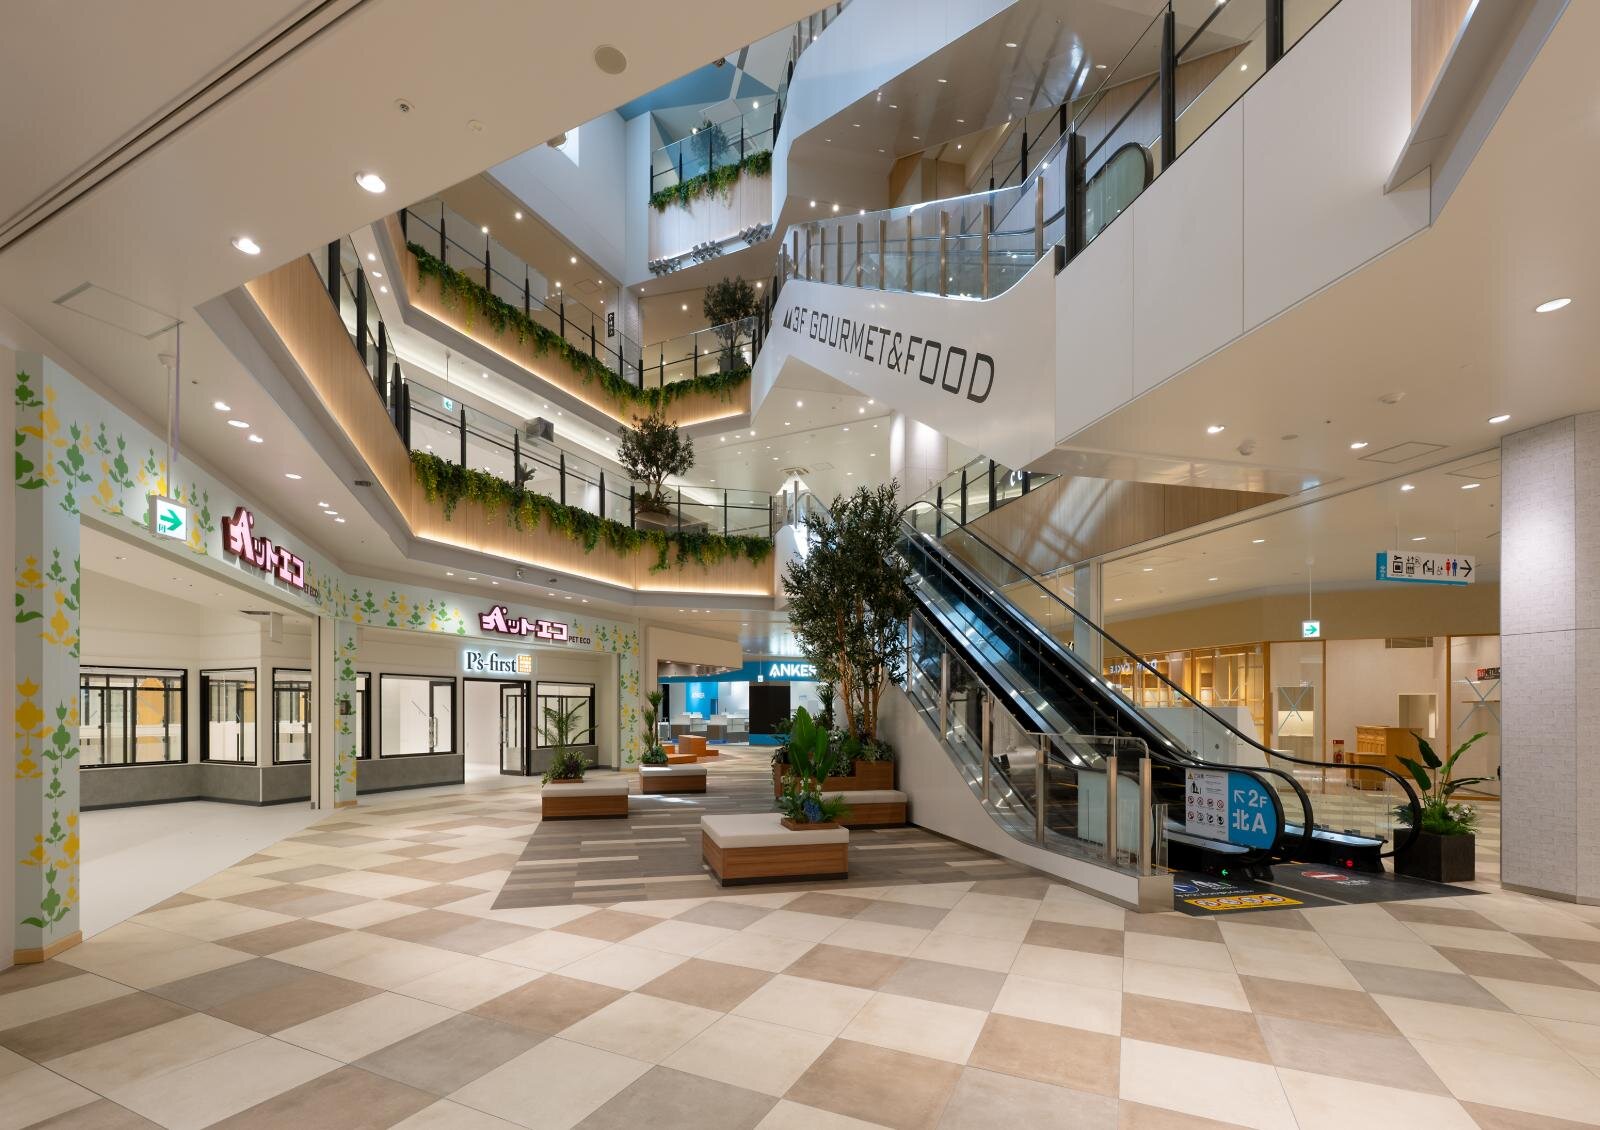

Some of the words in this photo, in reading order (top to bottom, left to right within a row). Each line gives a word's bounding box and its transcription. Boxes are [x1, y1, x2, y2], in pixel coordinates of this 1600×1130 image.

[793, 306, 808, 334] 3F
[809, 311, 995, 404] GOURMET&FOOD
[222, 507, 304, 589] ペットエコ
[479, 604, 568, 641] ペットエコ
[569, 635, 579, 643] PET
[580, 637, 591, 645] ECO
[1248, 789, 1268, 808] 2F
[1232, 808, 1268, 835] 北A
